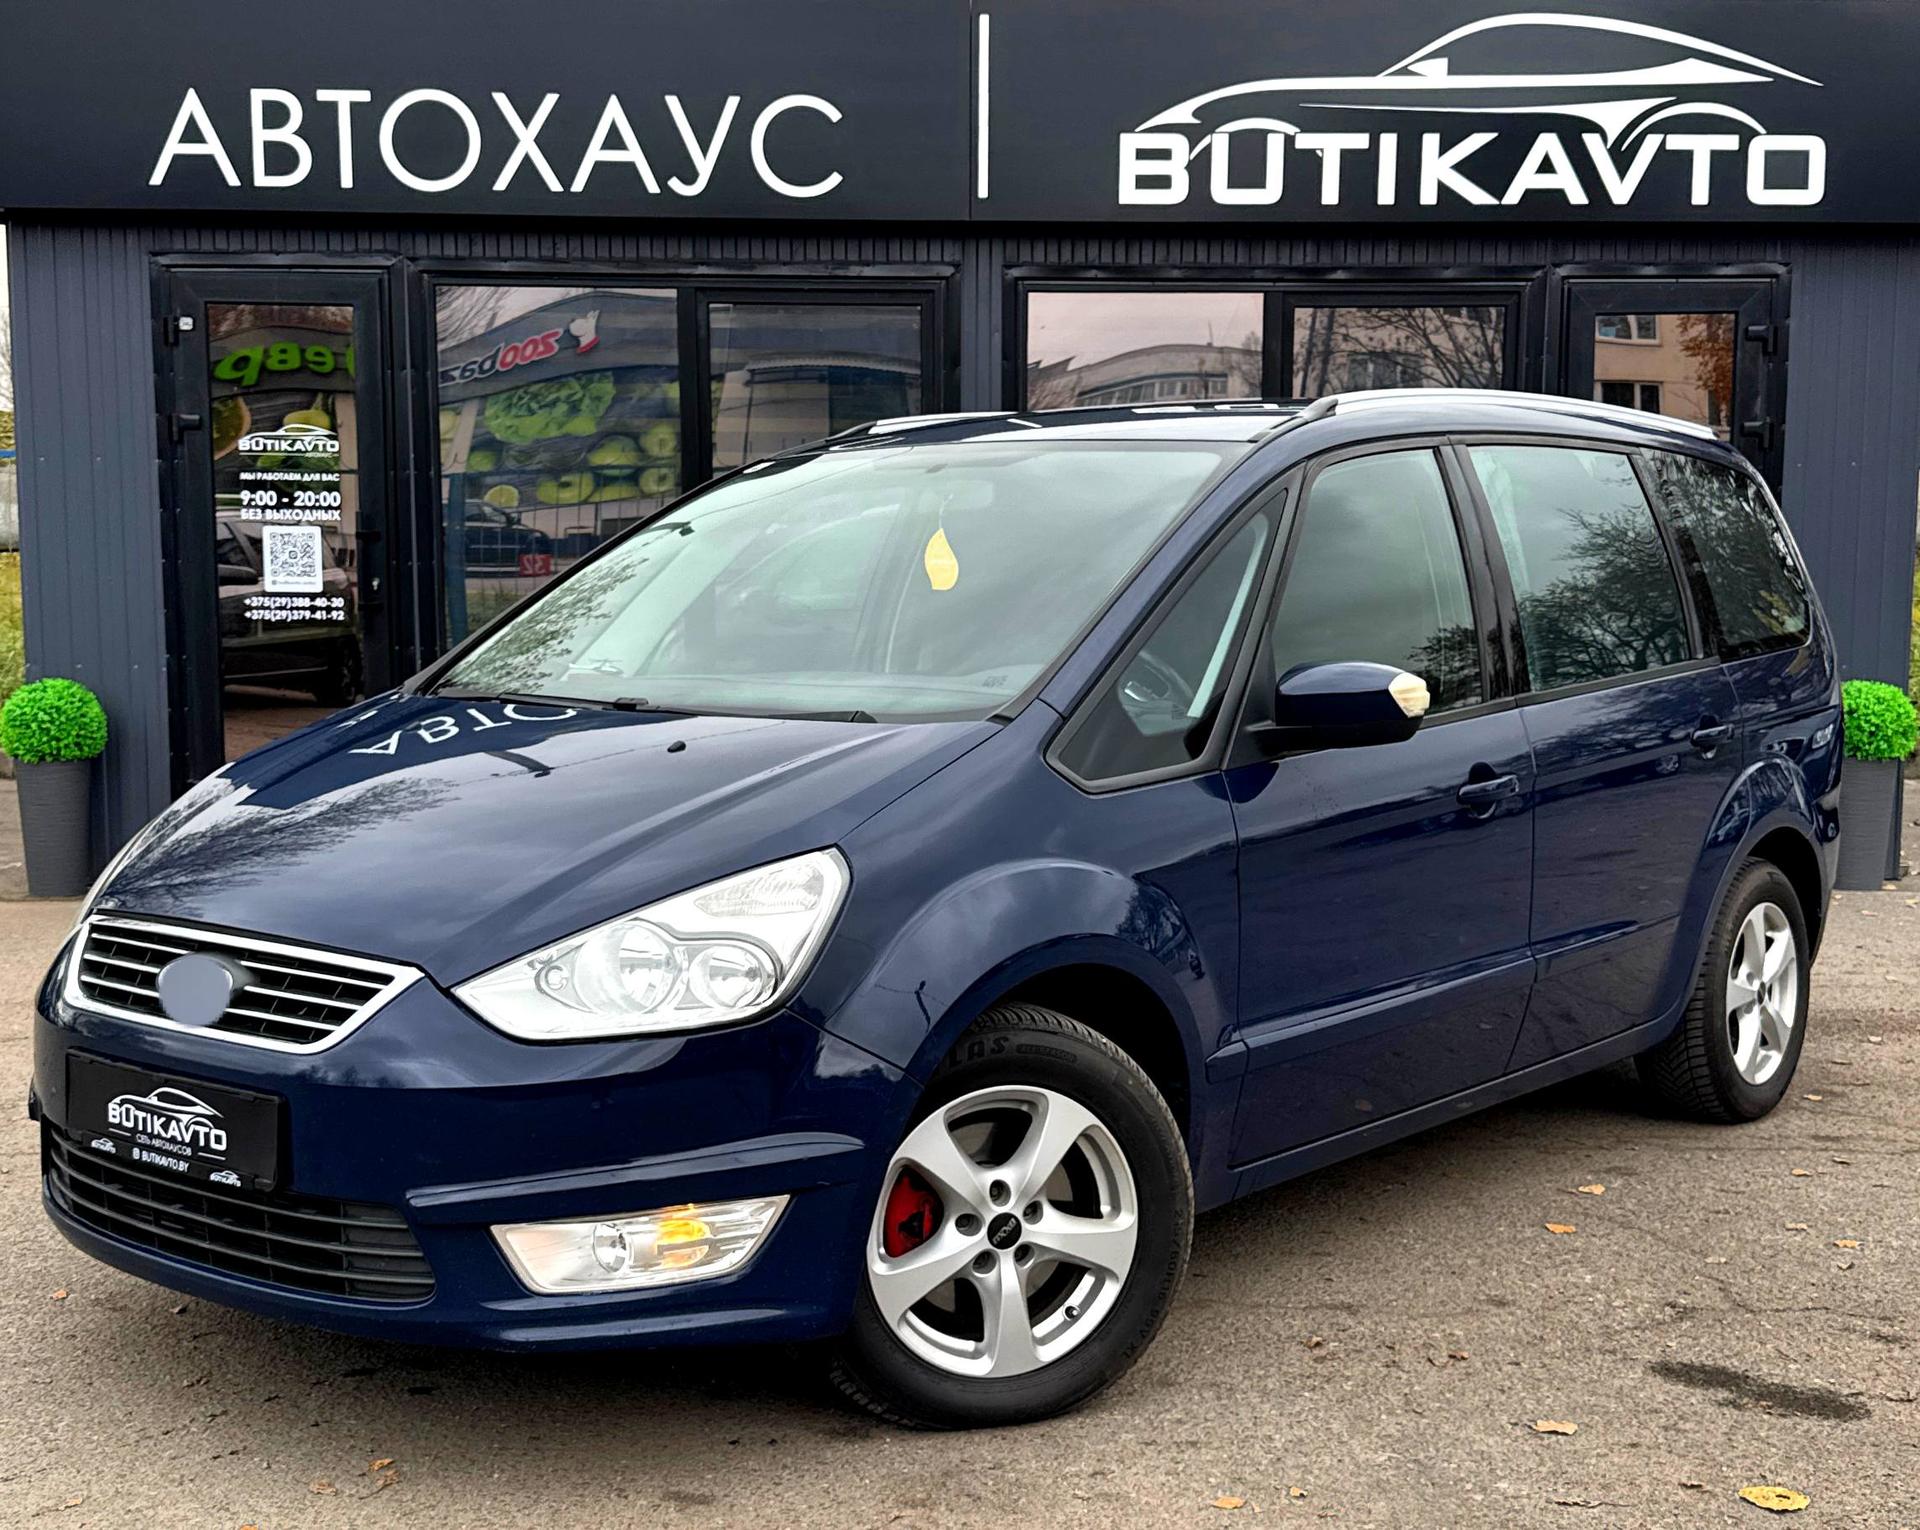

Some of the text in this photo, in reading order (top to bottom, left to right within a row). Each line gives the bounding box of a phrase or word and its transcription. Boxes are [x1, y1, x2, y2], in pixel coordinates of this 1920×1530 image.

[148, 87, 845, 198] АВТОХАУС
[1118, 131, 1827, 206] BUTIKAVTO
[238, 439, 340, 452] BUTIKAVTO
[240, 472, 340, 481] МЫ РАБОТАЕМ ДЛЯ ВАС
[240, 490, 277, 506] 9:00
[293, 490, 341, 506] 20:00
[241, 508, 341, 521] БЕЗ ВЫХОДНЫХ
[243, 610, 345, 622] +375(29)379-41-92
[107, 1102, 228, 1151] BUTIKAVTO
[141, 1150, 190, 1173] BUTIKAVTO.BY
